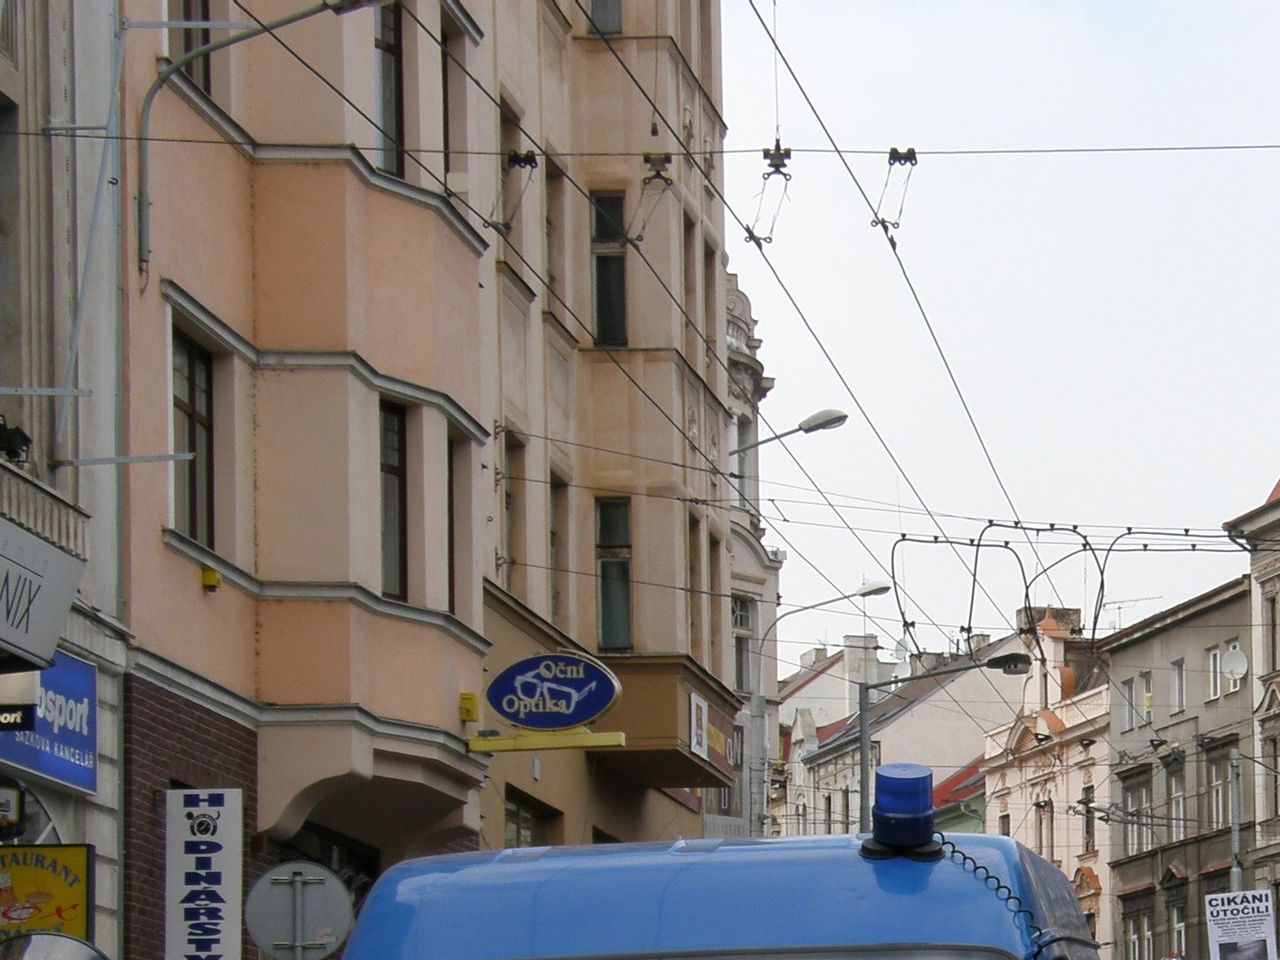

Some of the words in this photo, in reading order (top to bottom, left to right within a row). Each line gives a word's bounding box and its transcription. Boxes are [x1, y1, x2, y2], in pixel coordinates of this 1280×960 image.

[540, 660, 585, 679] Oční
[502, 694, 567, 718] Optika
[1208, 892, 1270, 908] CIKÁNI
[1210, 905, 1269, 918] ÚTOČILI
